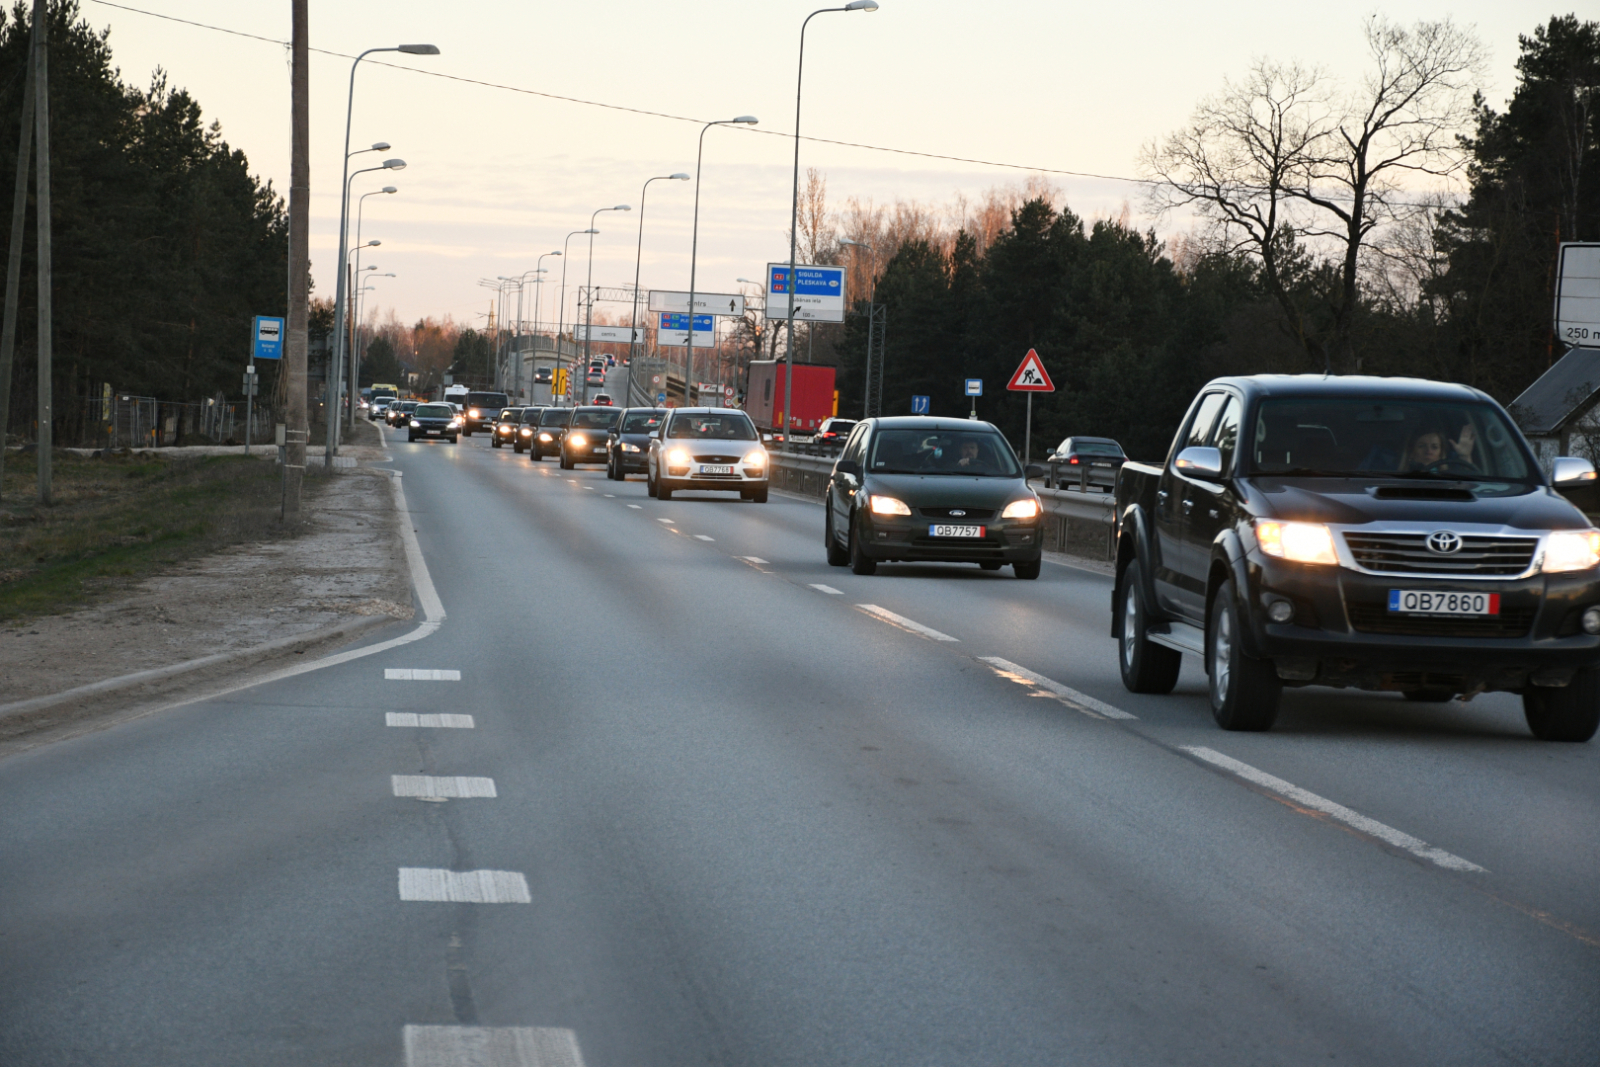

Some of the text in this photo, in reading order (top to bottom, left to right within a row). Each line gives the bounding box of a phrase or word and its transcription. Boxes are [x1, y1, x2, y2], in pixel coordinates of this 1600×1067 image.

[1567, 327, 1589, 339] 250
[937, 526, 978, 537] QB7757
[1404, 592, 1485, 612] QB7860
